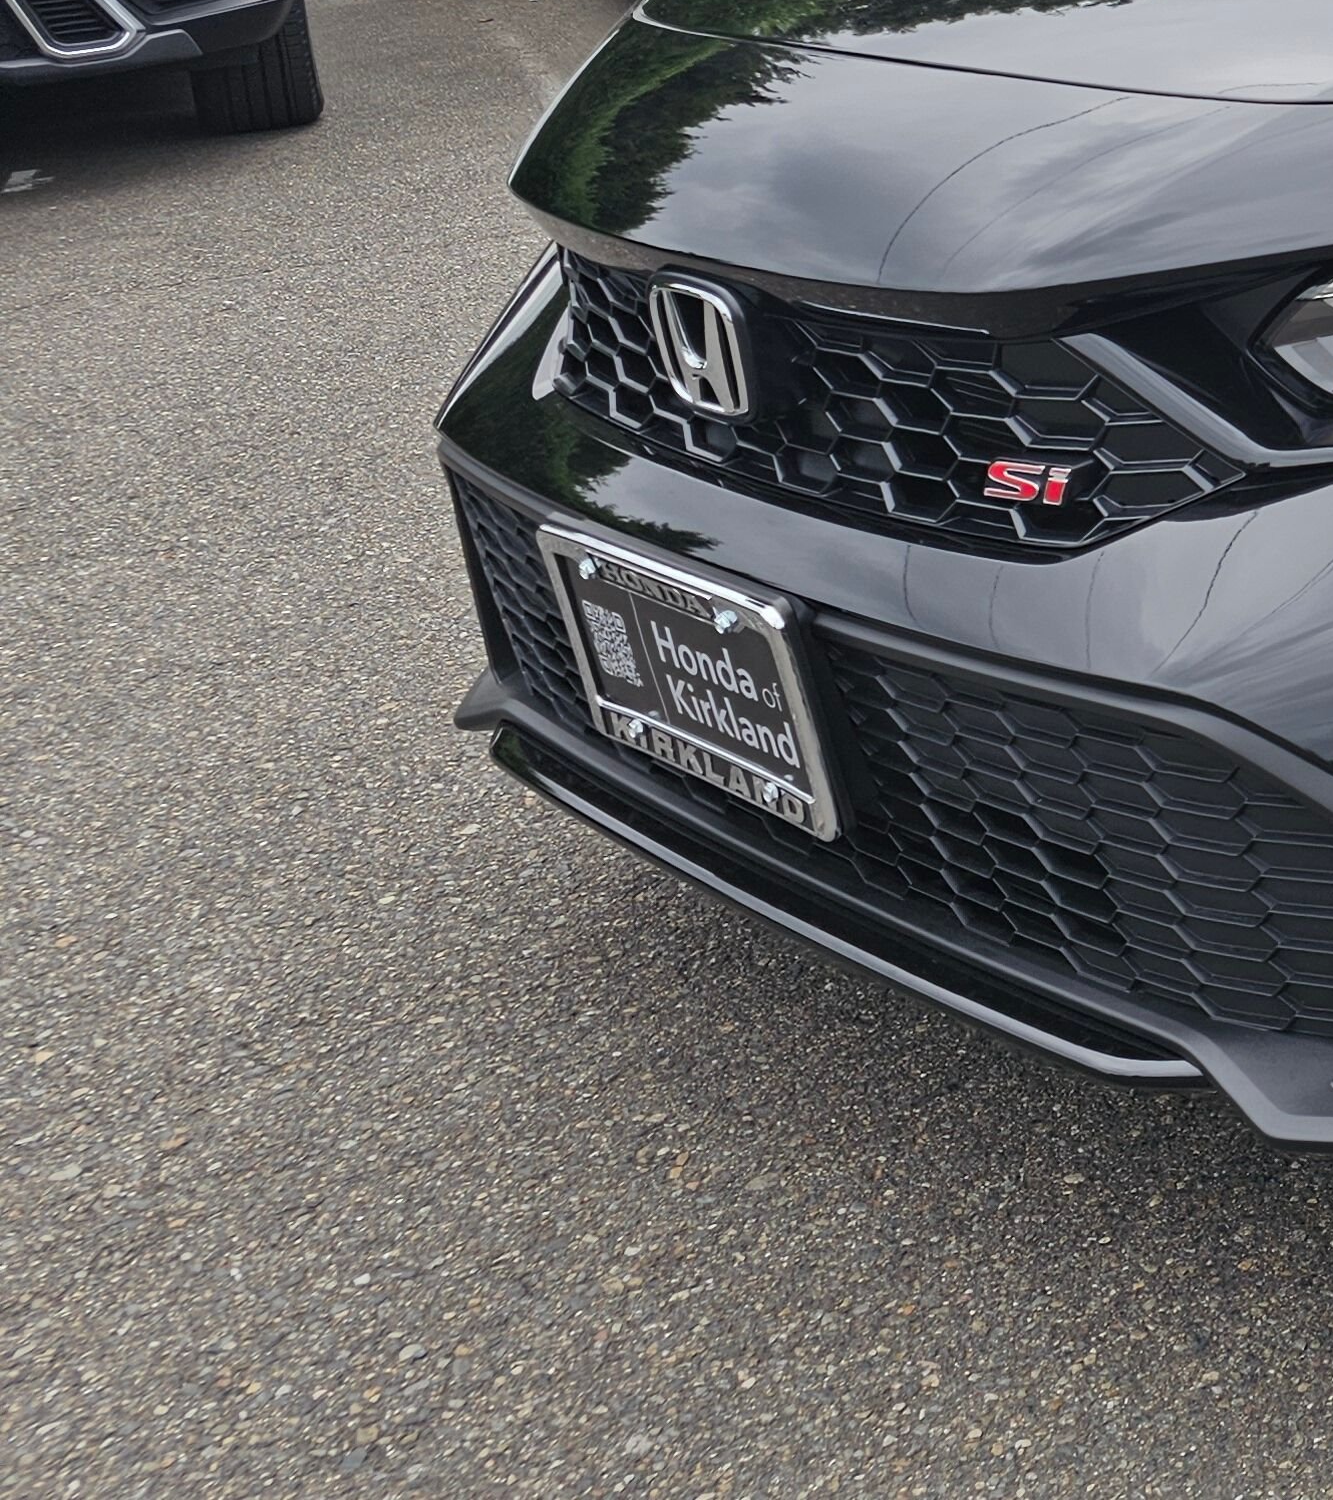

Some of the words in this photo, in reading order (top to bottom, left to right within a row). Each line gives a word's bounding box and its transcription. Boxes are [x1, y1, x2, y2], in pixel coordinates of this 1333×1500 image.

[983, 460, 1072, 505] Si
[650, 620, 759, 701] Honda
[762, 683, 783, 712] of
[666, 674, 800, 768] Kirkland
